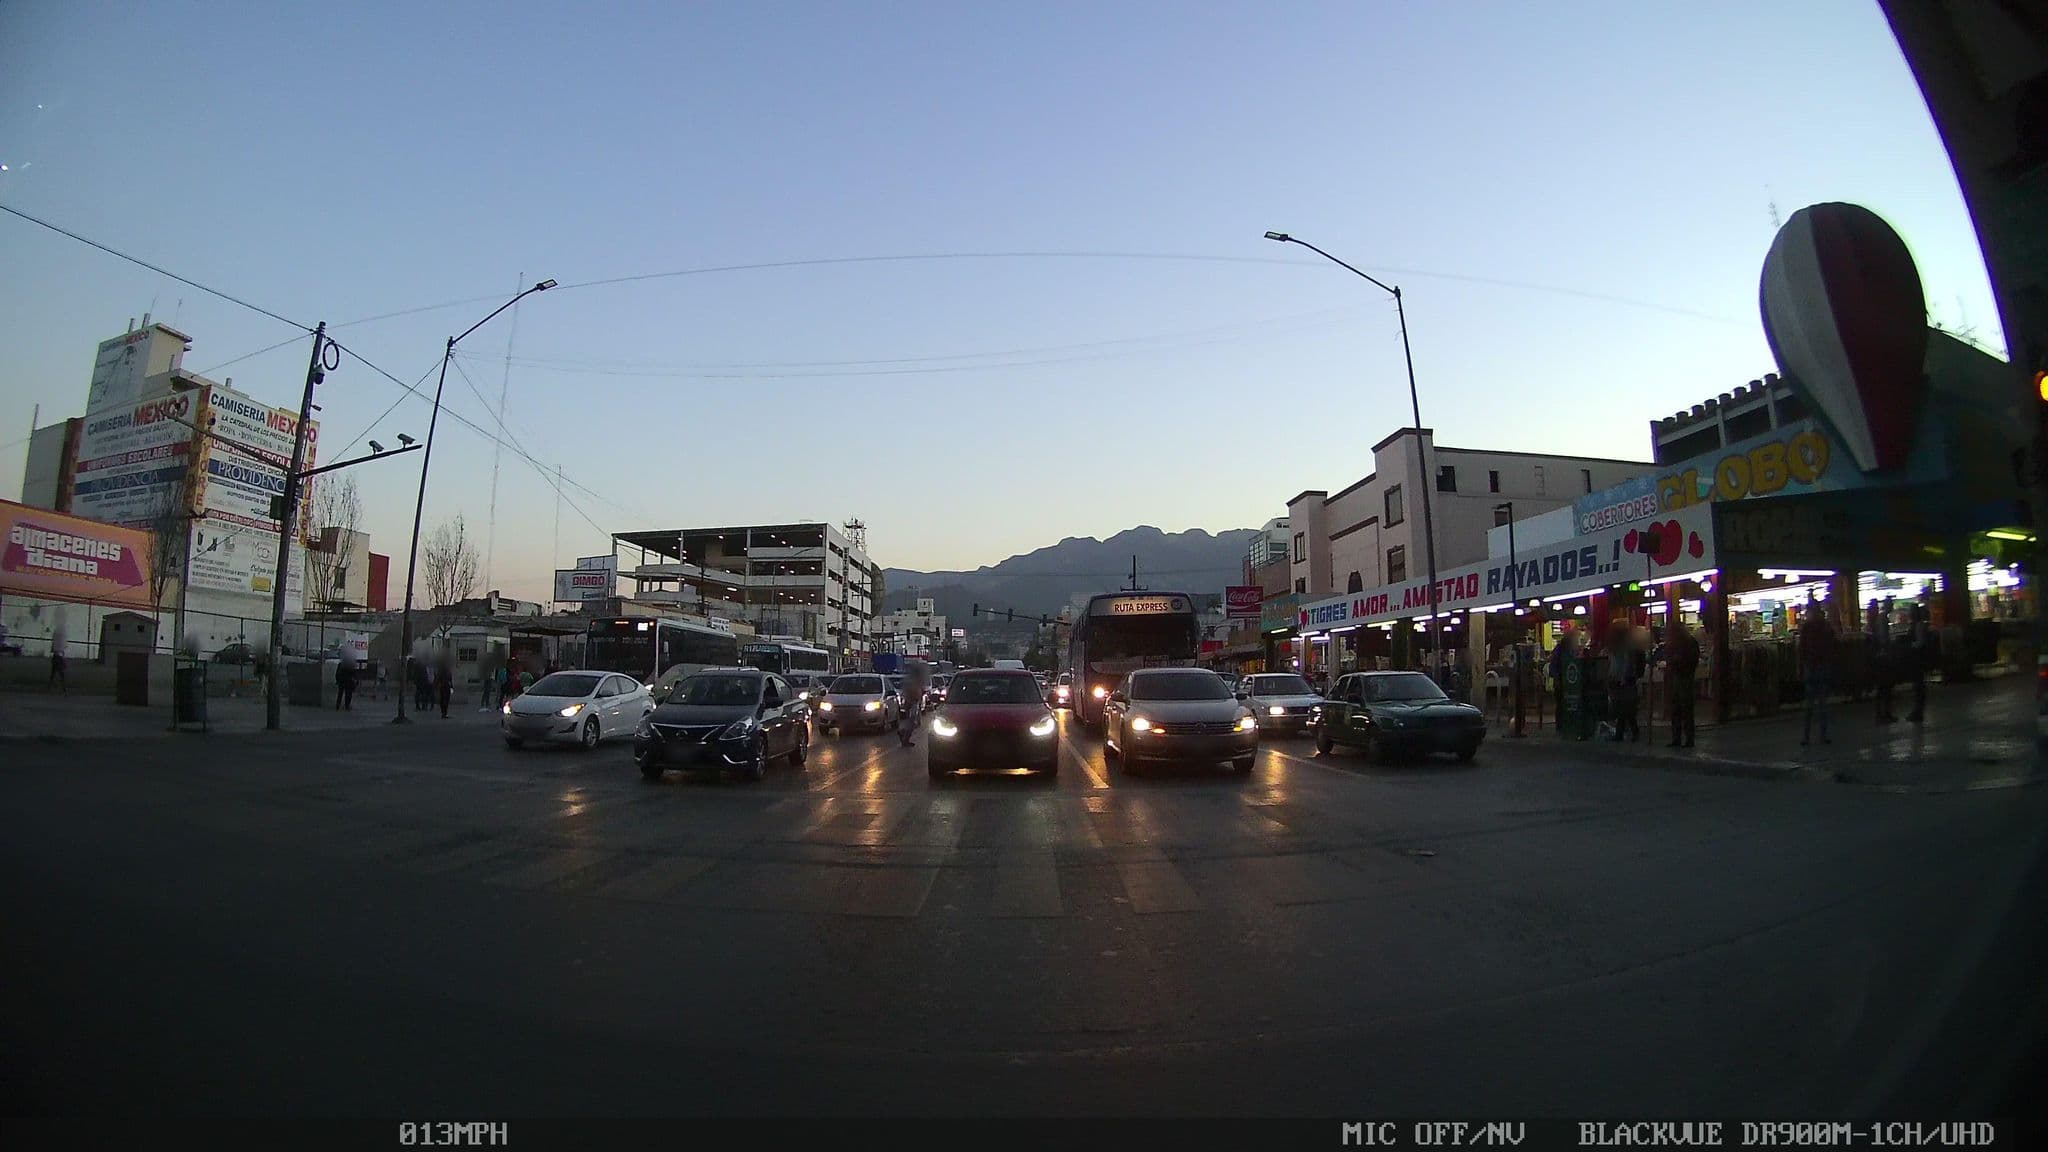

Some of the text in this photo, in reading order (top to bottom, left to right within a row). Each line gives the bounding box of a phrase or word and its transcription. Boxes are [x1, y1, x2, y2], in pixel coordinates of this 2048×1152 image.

[132, 396, 189, 427] MEXICO
[211, 393, 265, 423] CAMISERIA
[128, 446, 172, 463] ESCOLARES
[1657, 431, 1830, 513] GLOBO
[1579, 493, 1657, 535] COBERTORES
[12, 526, 121, 561] almacenes
[27, 547, 98, 575] diana
[1402, 573, 1479, 609] AMISTAD
[1114, 602, 1168, 612] RUTA EXPRESS
